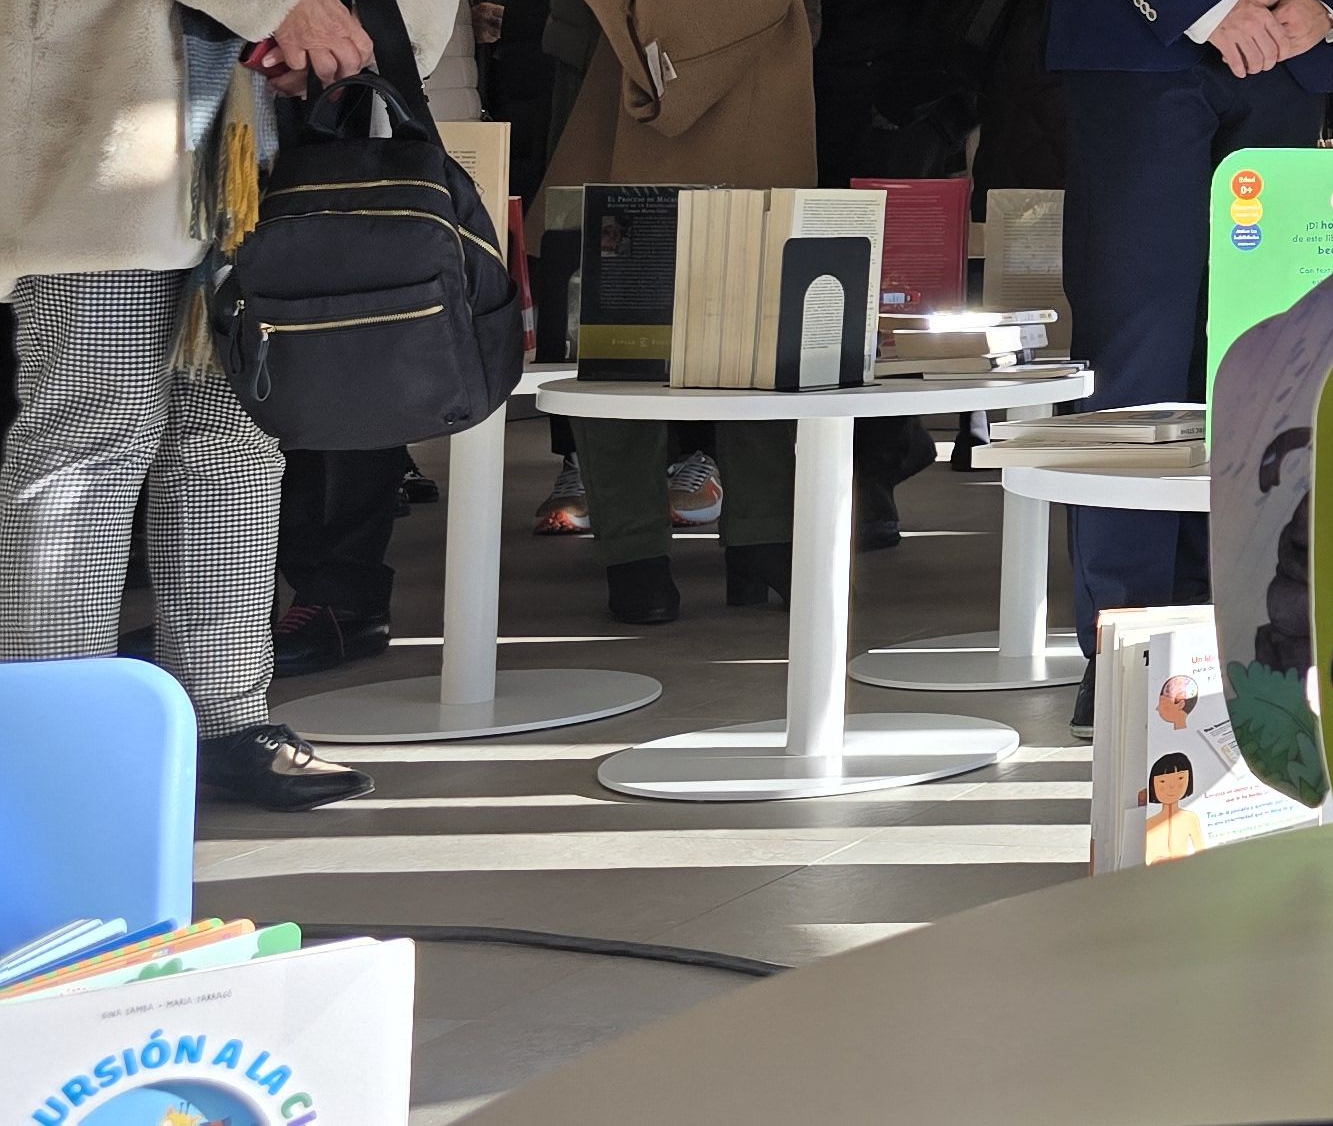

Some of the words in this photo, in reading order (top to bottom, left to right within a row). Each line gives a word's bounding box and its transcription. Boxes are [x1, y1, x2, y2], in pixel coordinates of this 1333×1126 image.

[1292, 234, 1304, 243] de
[1306, 235, 1323, 243] este
[212, 1038, 244, 1069] A
[244, 1050, 293, 1096] LA
